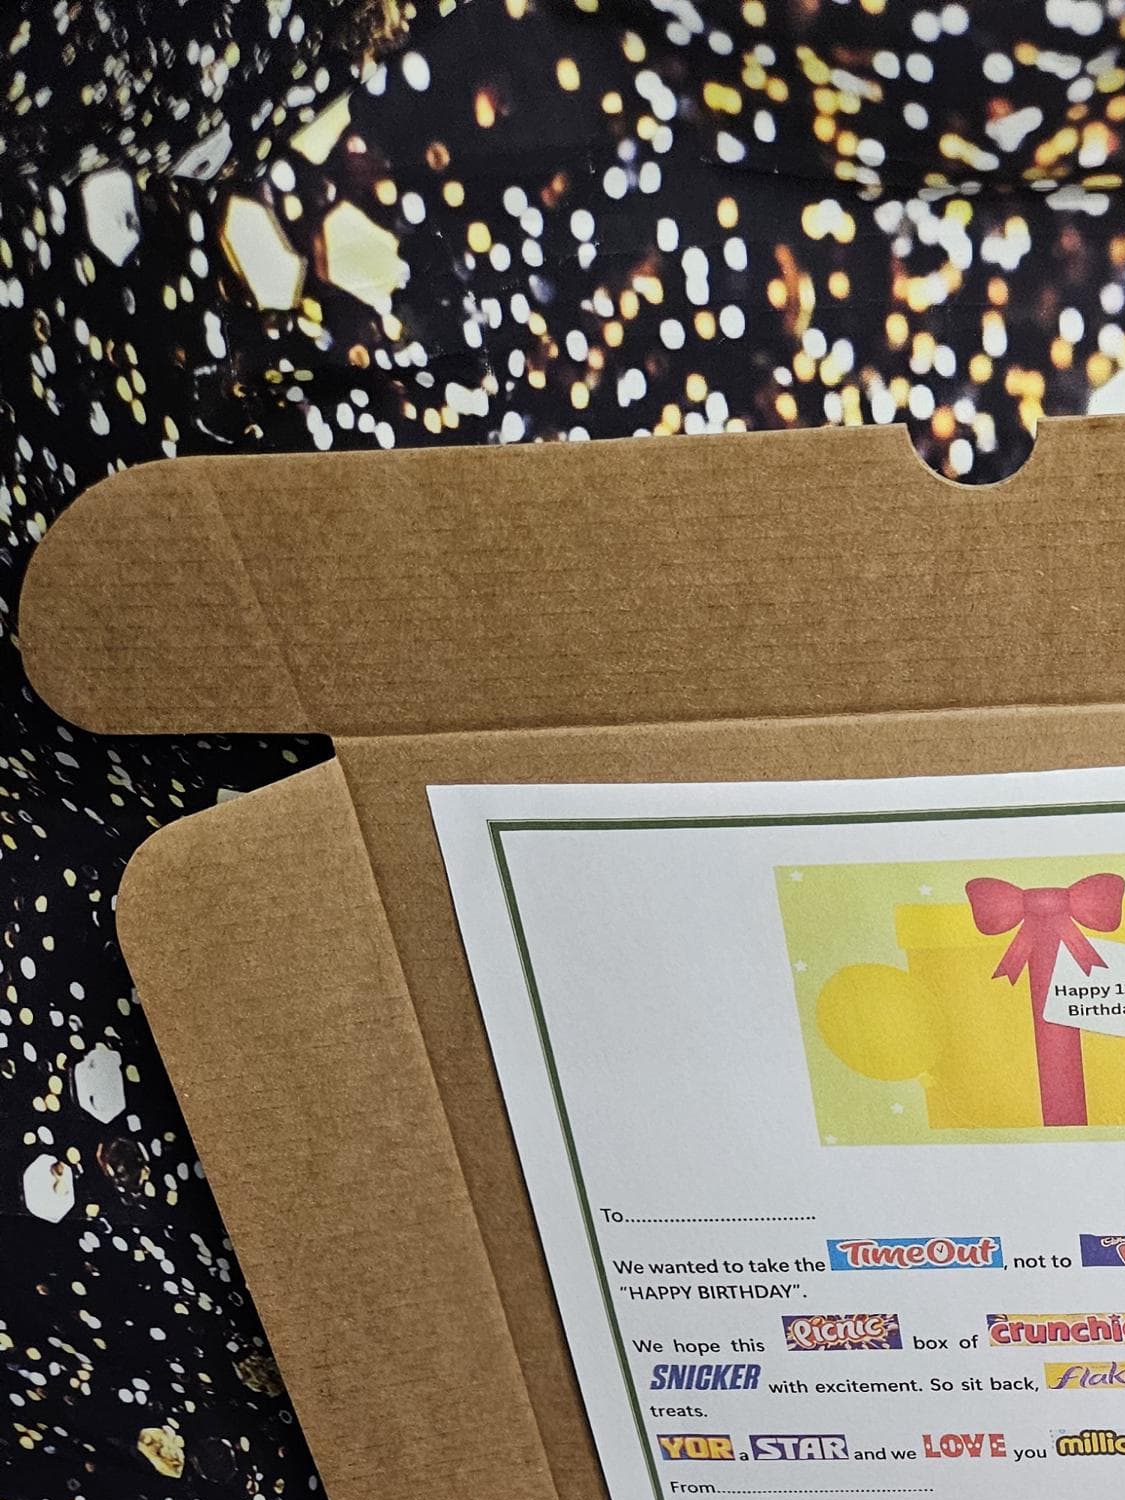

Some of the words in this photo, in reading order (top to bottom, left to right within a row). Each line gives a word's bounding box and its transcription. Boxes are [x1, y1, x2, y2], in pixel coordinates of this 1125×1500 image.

[1054, 982, 1110, 999] Happy
[613, 1260, 644, 1275] We
[649, 1259, 718, 1275] wanted
[722, 1260, 743, 1274] to
[748, 1257, 790, 1274] take
[795, 1256, 826, 1273] the
[1013, 1253, 1045, 1269] not
[1051, 1254, 1072, 1269] to
[633, 1339, 664, 1354] We
[674, 1338, 720, 1357] hope
[731, 1336, 765, 1354] this
[788, 1317, 886, 1349] Picnic
[913, 1335, 948, 1351] box
[959, 1334, 979, 1350] of
[649, 1363, 762, 1392] SNICKER
[769, 1379, 809, 1395] with
[815, 1376, 923, 1394] excitement.
[930, 1377, 955, 1393] So
[961, 1376, 984, 1393] sit
[990, 1375, 1040, 1394] back,
[650, 1404, 708, 1419] treats.
[658, 1436, 735, 1461] YOR
[739, 1449, 749, 1462] a
[753, 1436, 850, 1461] STAR
[854, 1445, 887, 1461] and
[891, 1447, 917, 1461] we
[922, 1433, 1006, 1459] LOVE
[1014, 1446, 1047, 1463] you
